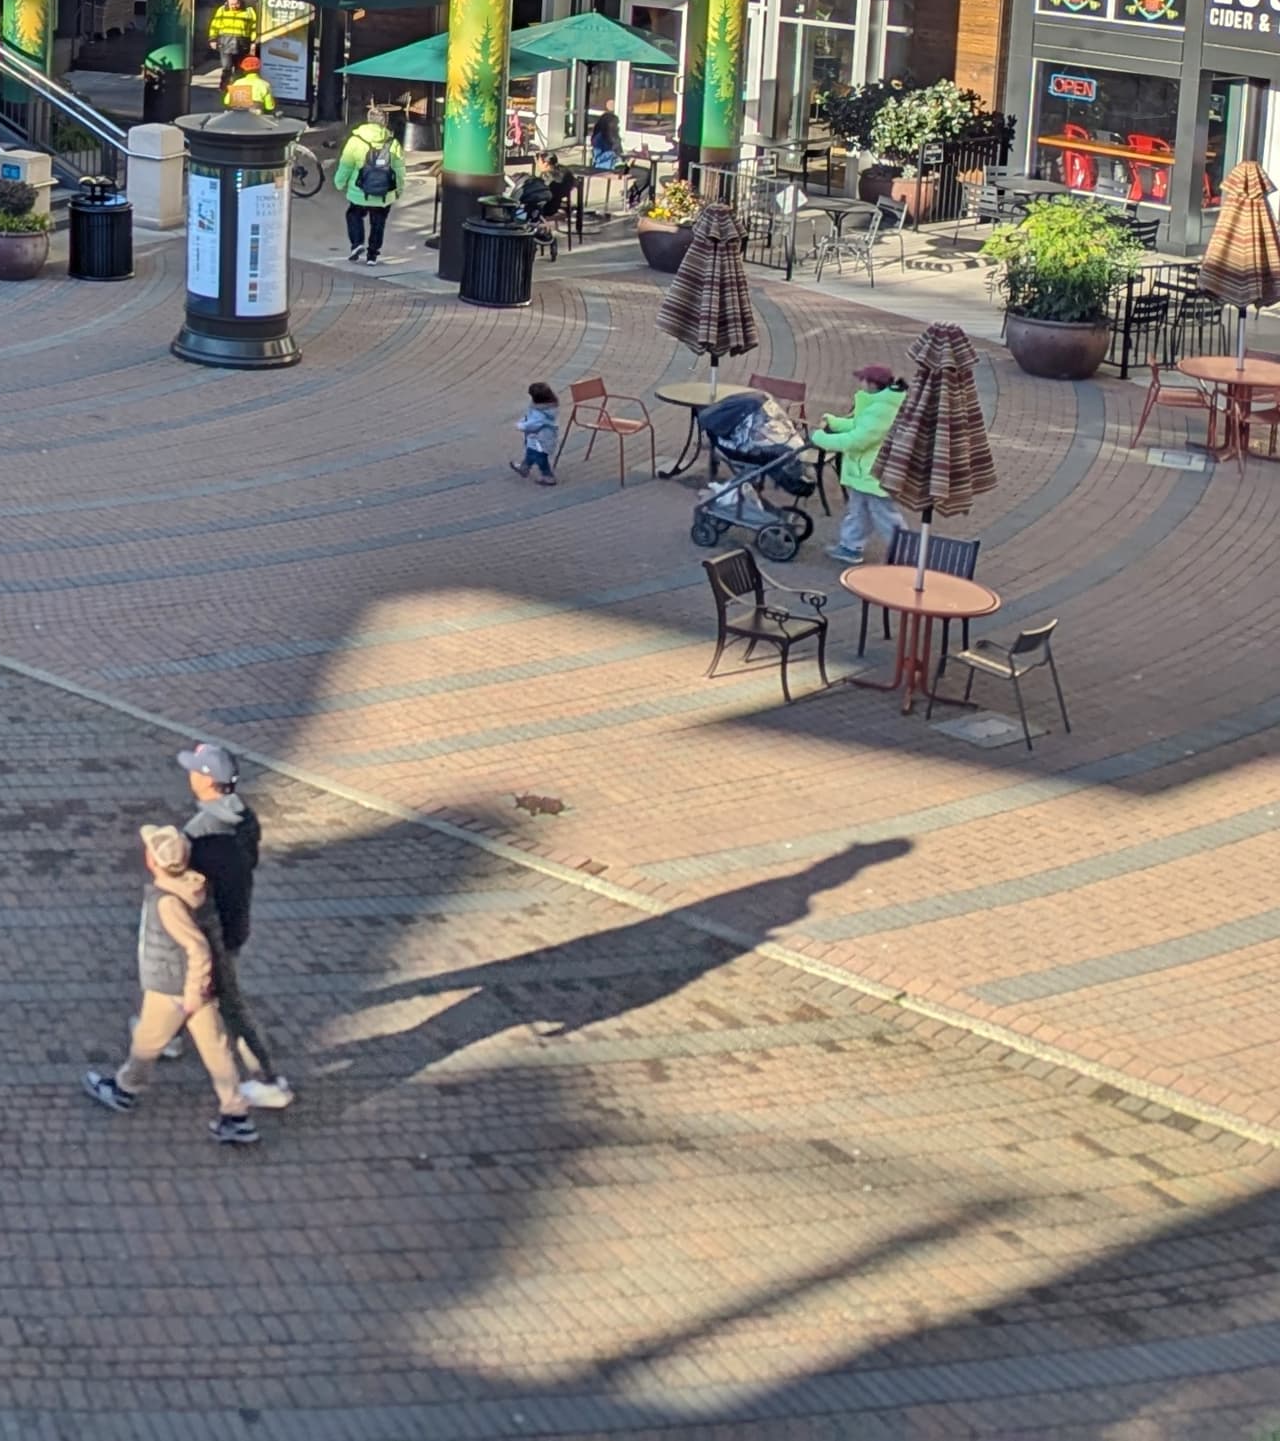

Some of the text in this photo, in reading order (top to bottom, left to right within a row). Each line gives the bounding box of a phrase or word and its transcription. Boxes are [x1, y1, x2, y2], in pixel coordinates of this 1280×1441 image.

[1209, 7, 1254, 31] CIDER
[1258, 13, 1271, 32] &
[1054, 77, 1094, 97] OPEN
